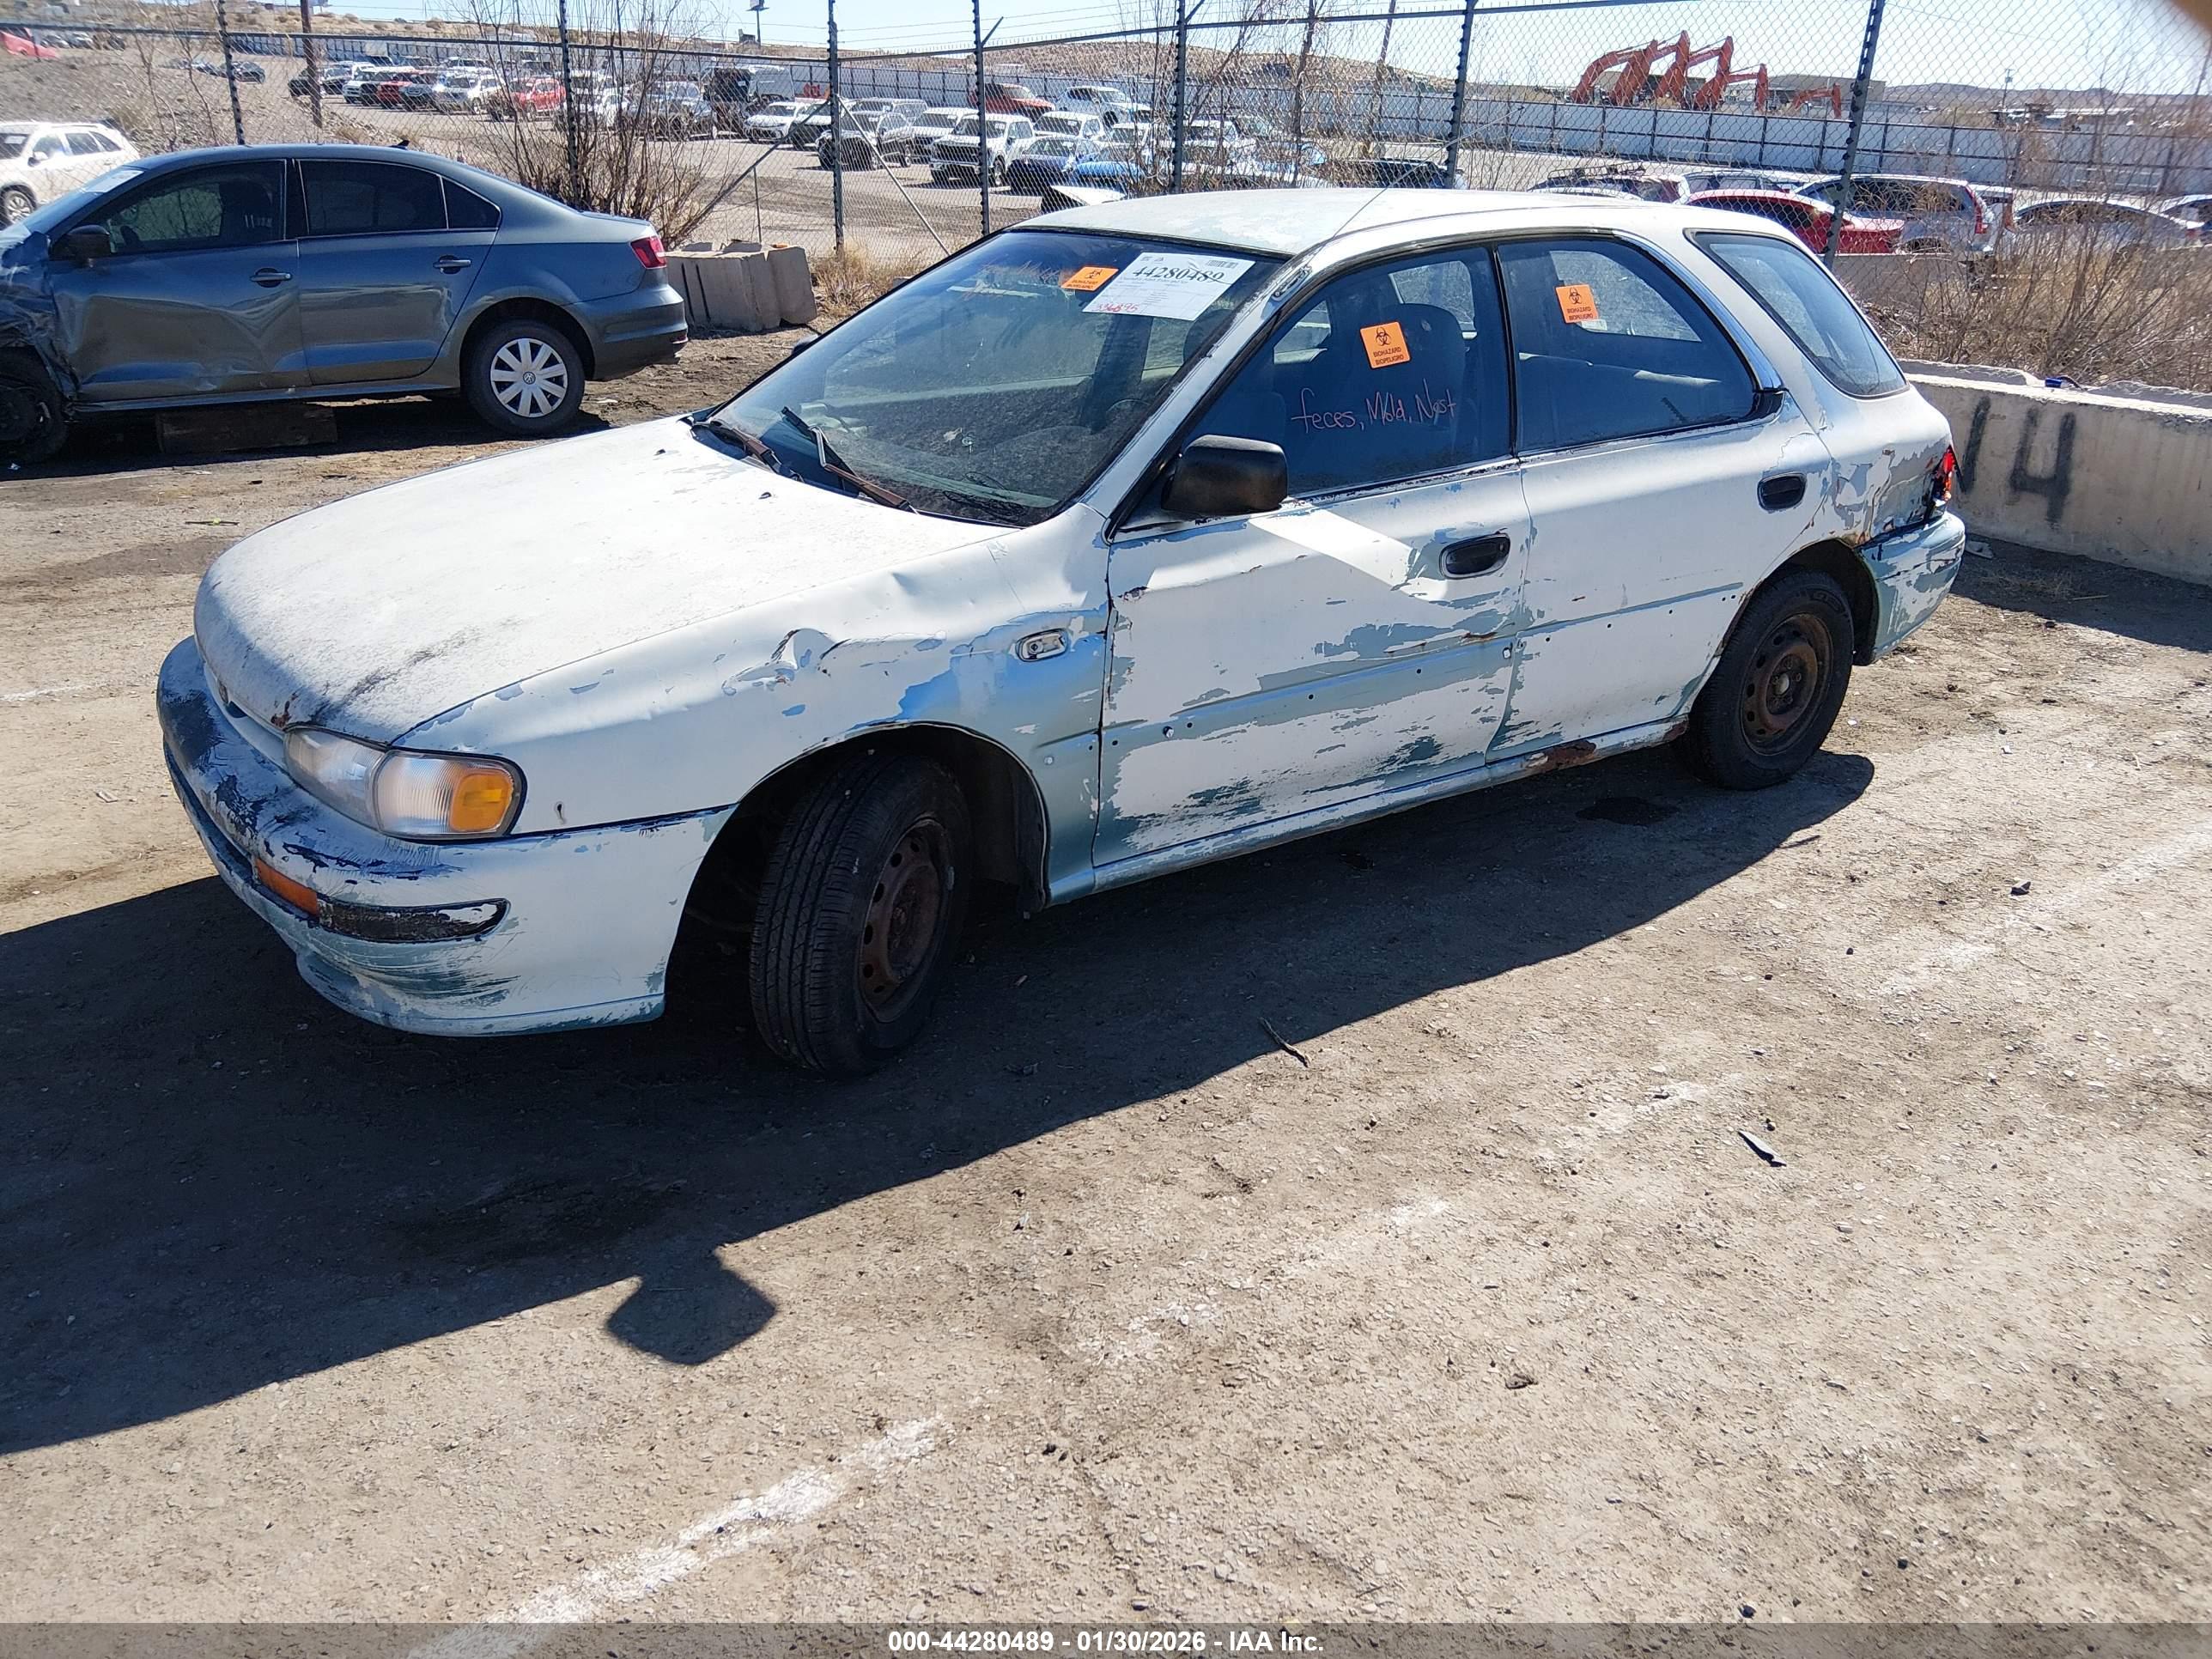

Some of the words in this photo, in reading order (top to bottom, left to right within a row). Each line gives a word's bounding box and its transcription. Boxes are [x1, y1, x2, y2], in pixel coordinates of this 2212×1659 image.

[1133, 266, 1224, 283] 44280489
[1373, 347, 1402, 358] BIOHAZARD
[1376, 355, 1405, 366] BIOPELIGRO
